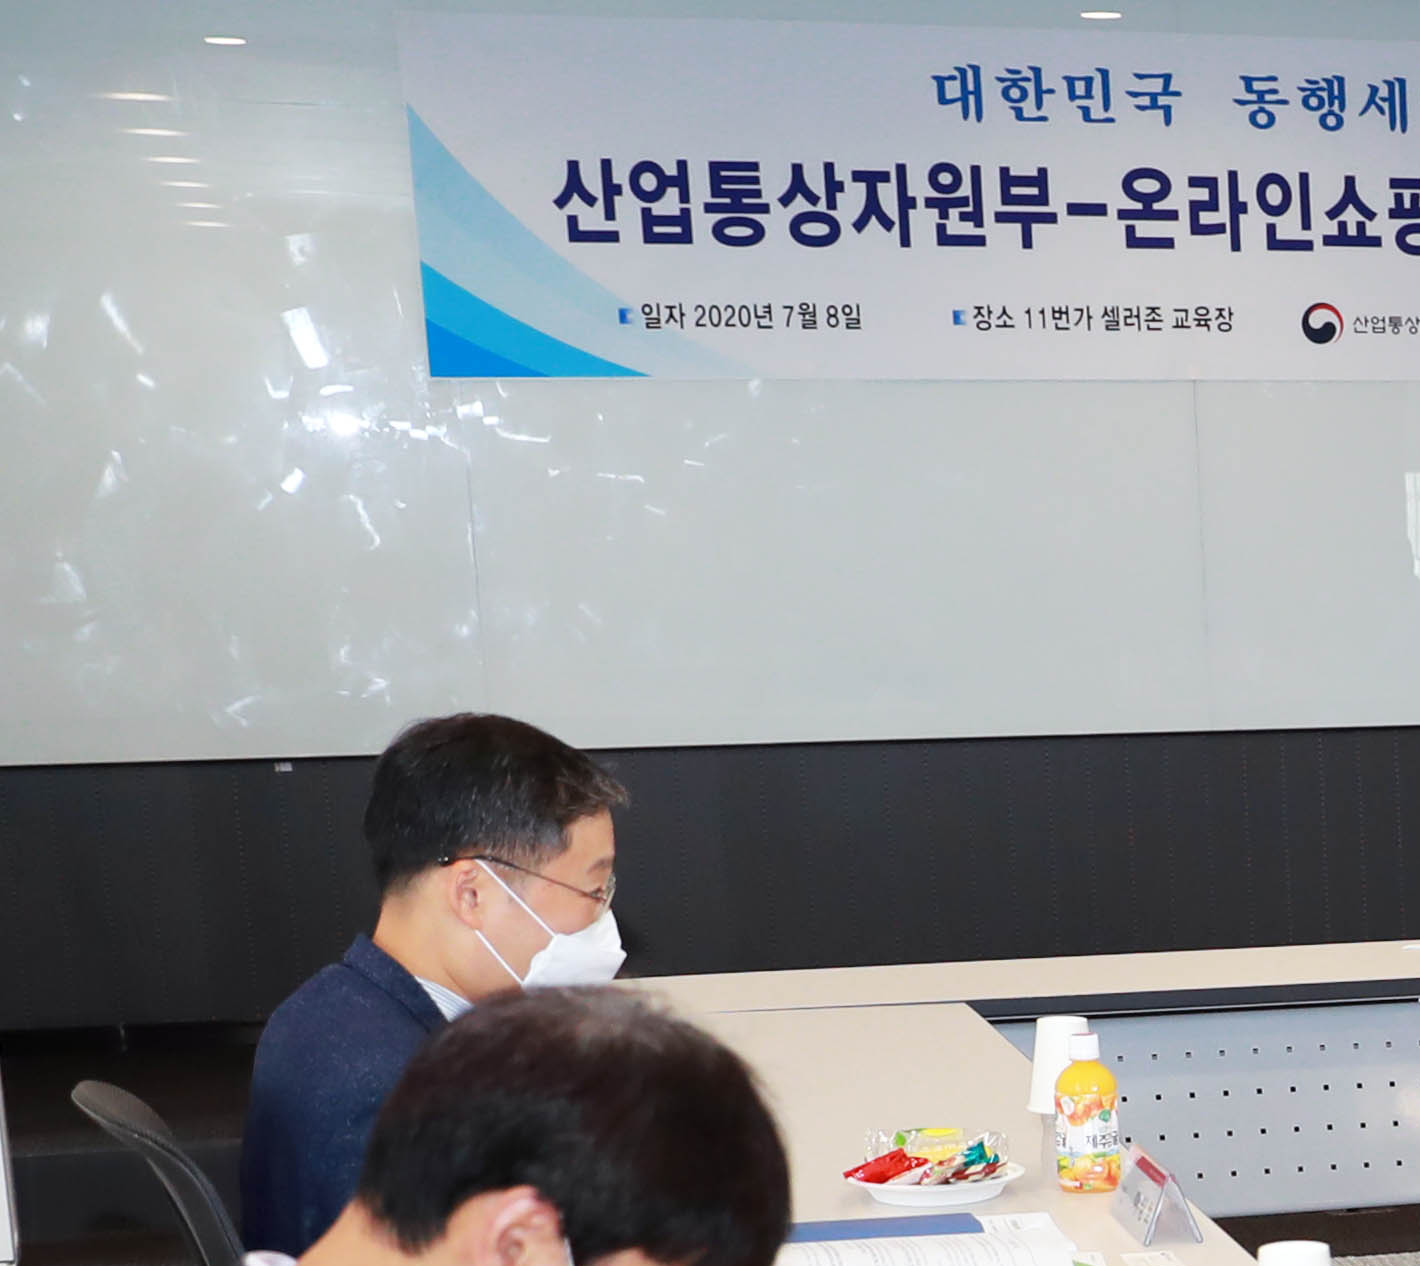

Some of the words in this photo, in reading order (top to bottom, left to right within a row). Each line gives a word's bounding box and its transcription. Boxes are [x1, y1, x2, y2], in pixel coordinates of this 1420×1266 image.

[931, 64, 1182, 127] 대한민국
[641, 303, 685, 329] 일자
[694, 303, 773, 329] 2020년
[782, 302, 817, 329] 7월
[826, 304, 861, 329] 8일
[973, 305, 1015, 331] 장소
[1025, 305, 1093, 331] 11번가
[1101, 306, 1163, 331] 셀러존
[1172, 306, 1234, 332] 교육장
